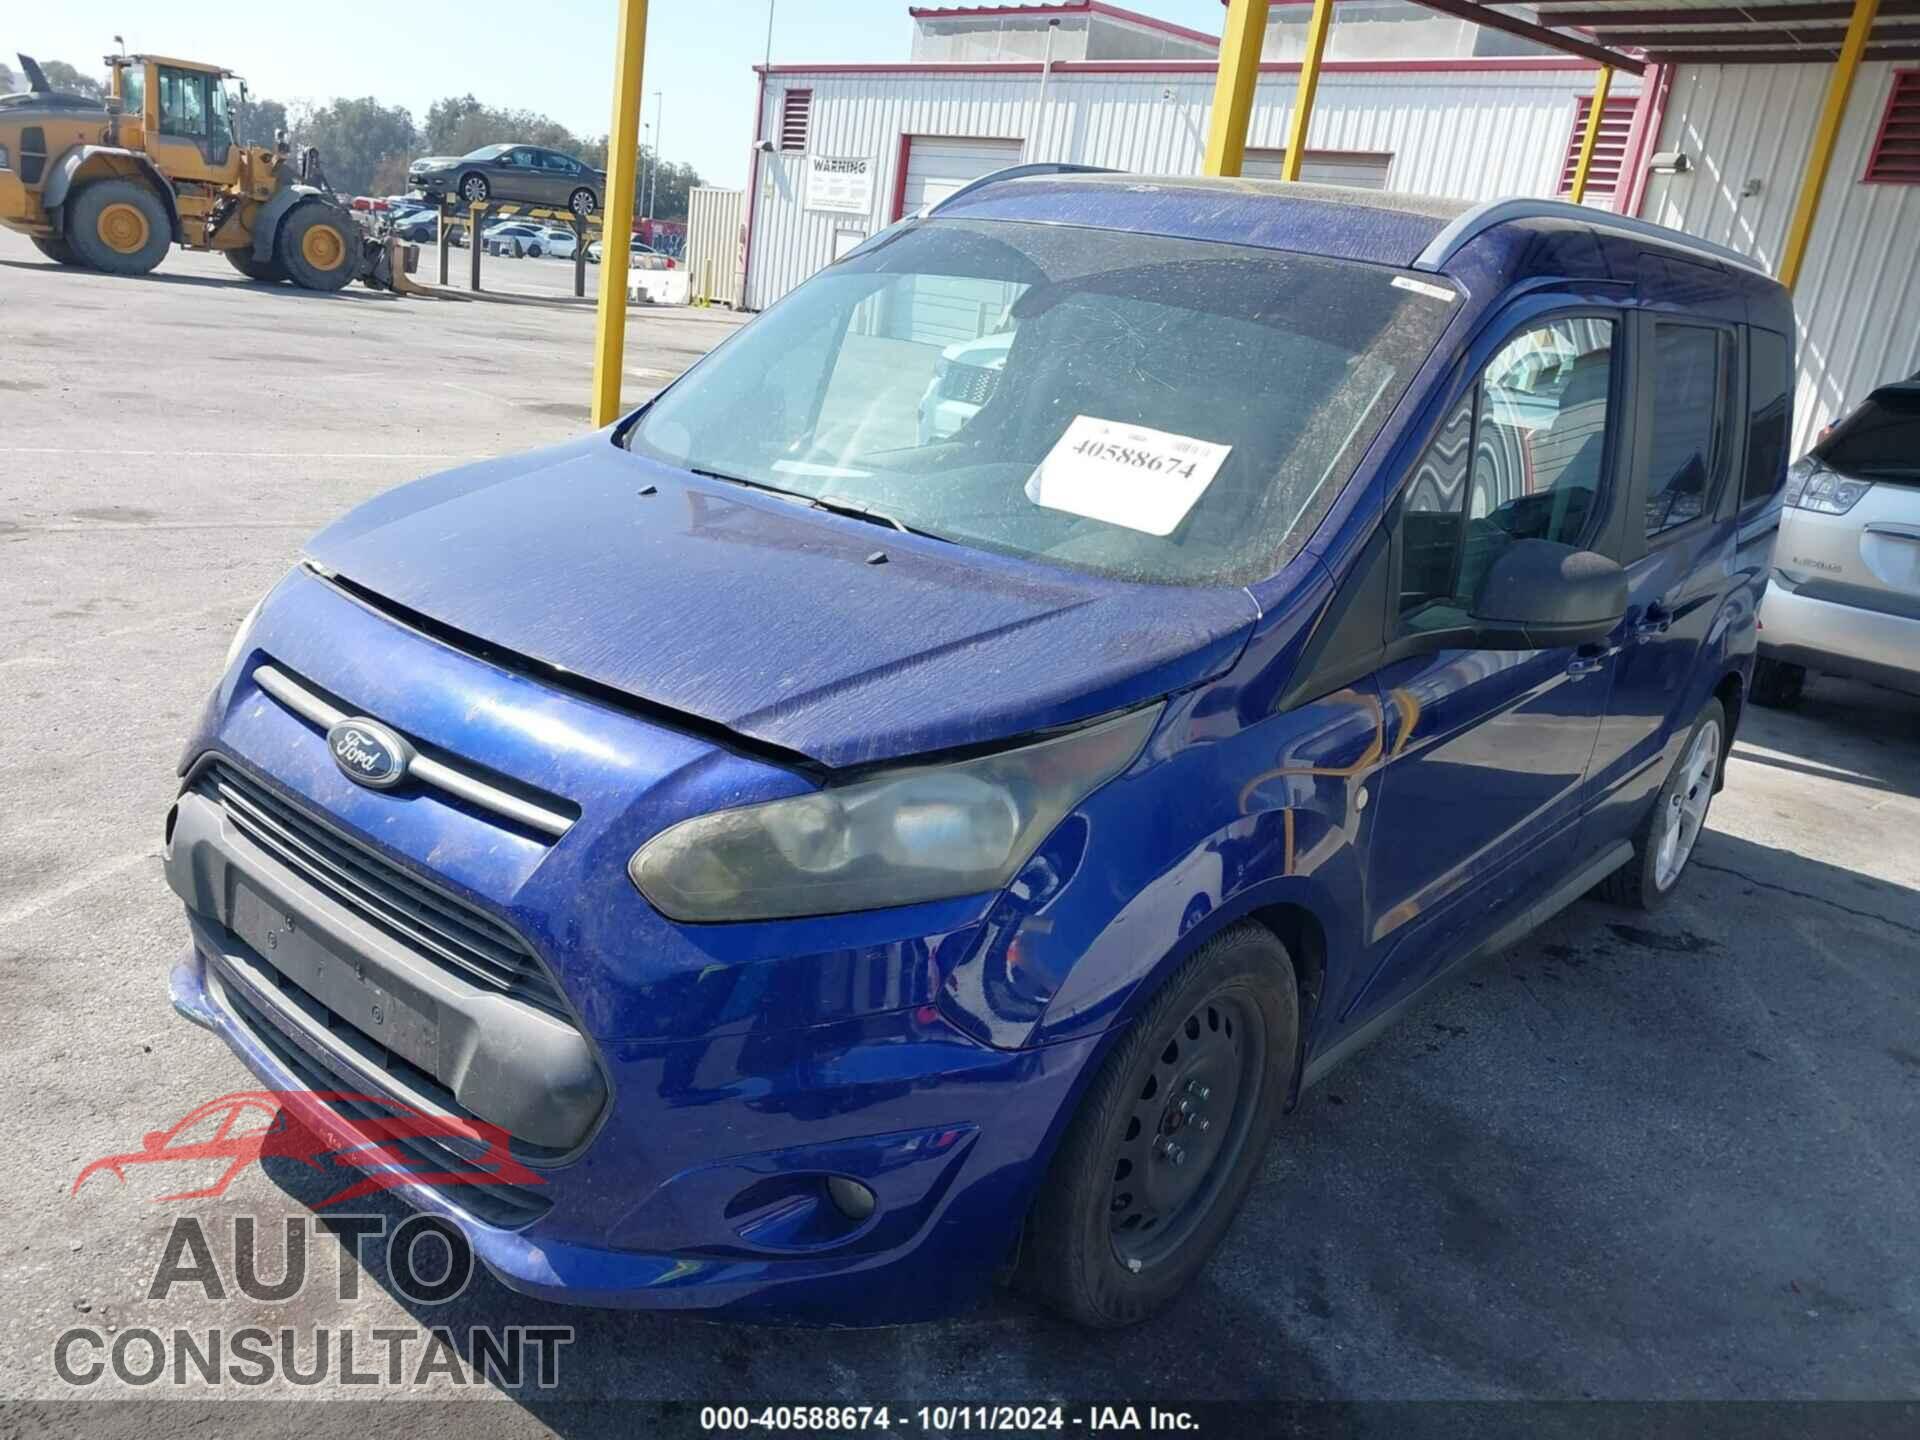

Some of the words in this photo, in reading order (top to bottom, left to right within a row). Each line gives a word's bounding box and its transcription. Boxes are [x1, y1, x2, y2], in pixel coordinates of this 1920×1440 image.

[813, 159, 867, 174] WARNING
[1072, 439, 1198, 479] 40588674
[336, 729, 381, 771] Ford
